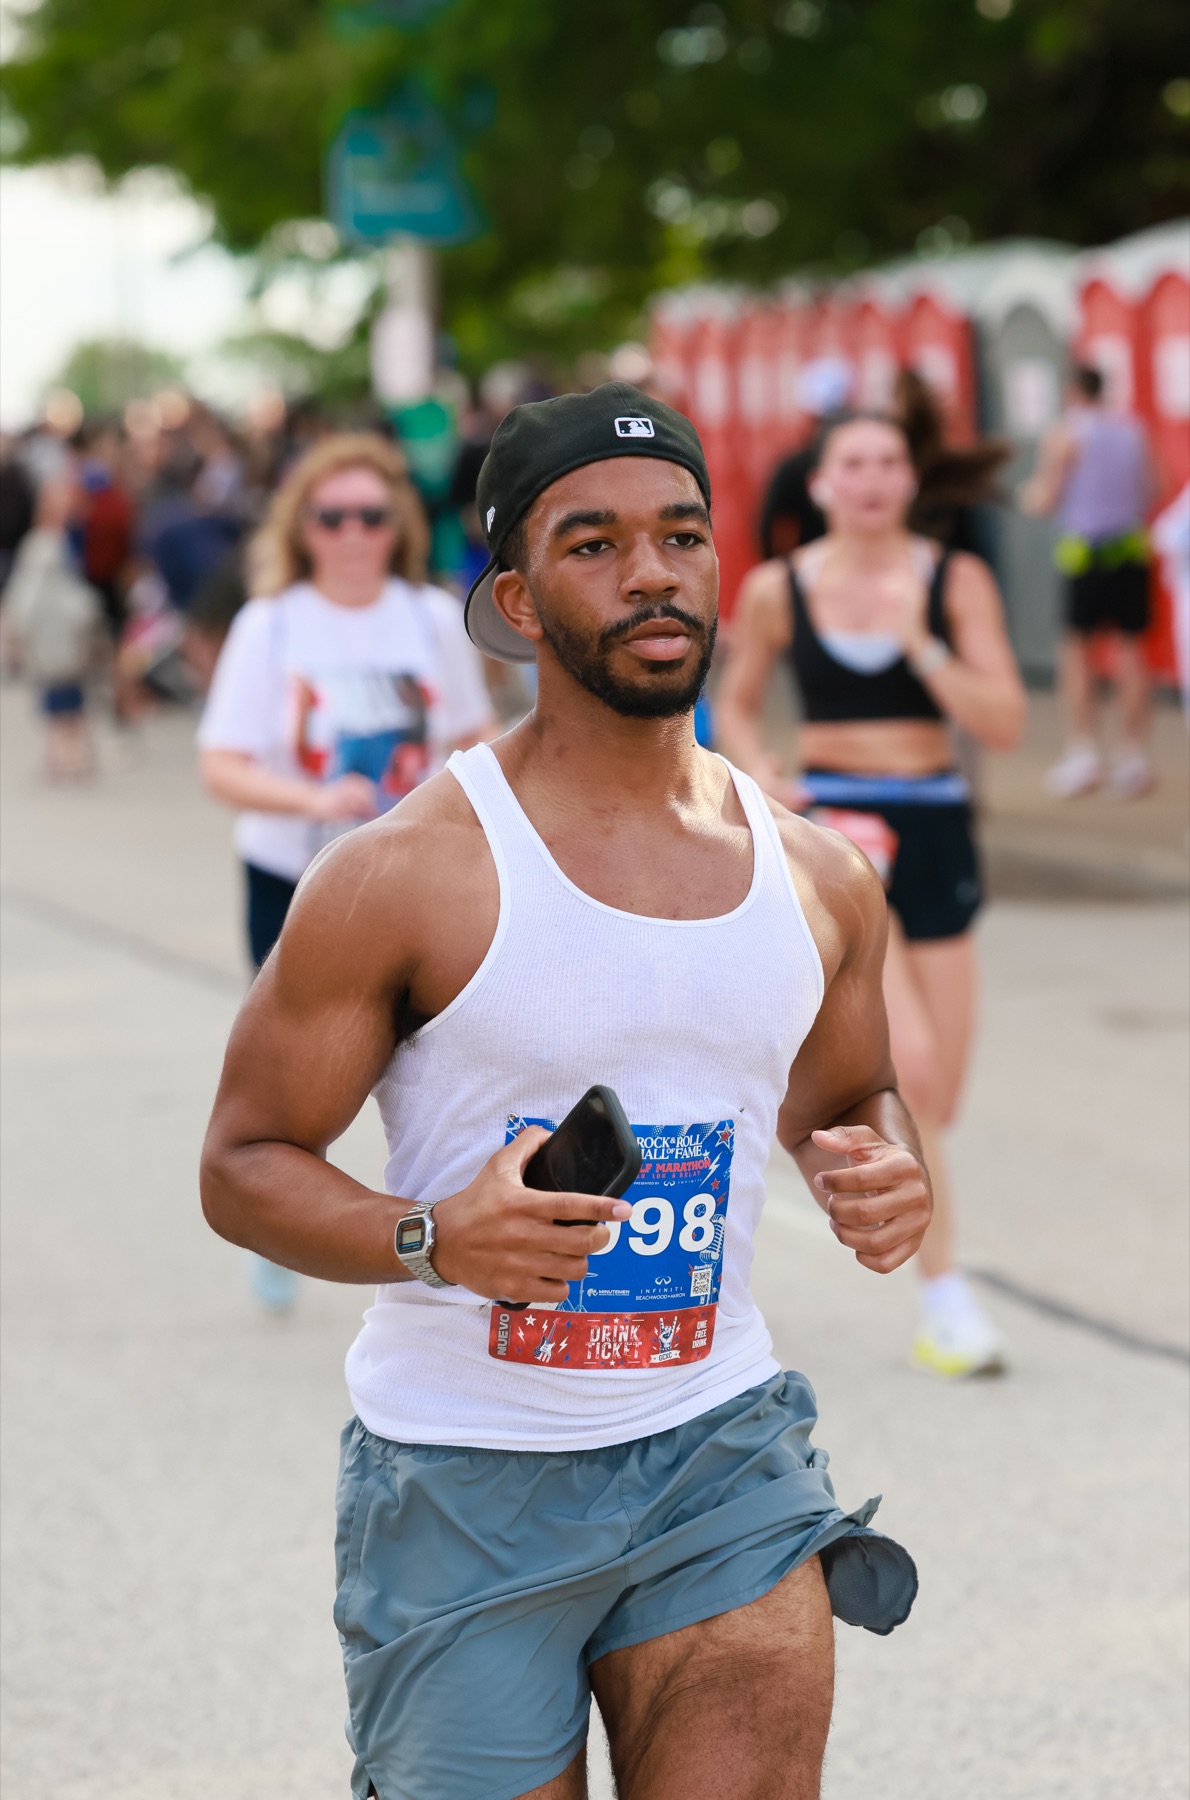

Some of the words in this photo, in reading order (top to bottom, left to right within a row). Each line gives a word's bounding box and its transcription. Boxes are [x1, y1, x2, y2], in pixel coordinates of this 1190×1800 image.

[636, 1137, 670, 1149] ROCK
[676, 1134, 703, 1147] ROLL
[674, 1146, 703, 1159] FAME
[639, 1163, 652, 1173] LF
[655, 1158, 711, 1173] MARATHON
[640, 1286, 683, 1294] INFINITI
[697, 1320, 708, 1329] ONE
[497, 1313, 510, 1356] NUEVO
[590, 1325, 640, 1343] DRINK
[695, 1329, 707, 1339] FREE
[585, 1341, 642, 1360] TICKET
[692, 1338, 708, 1349] DRINK
